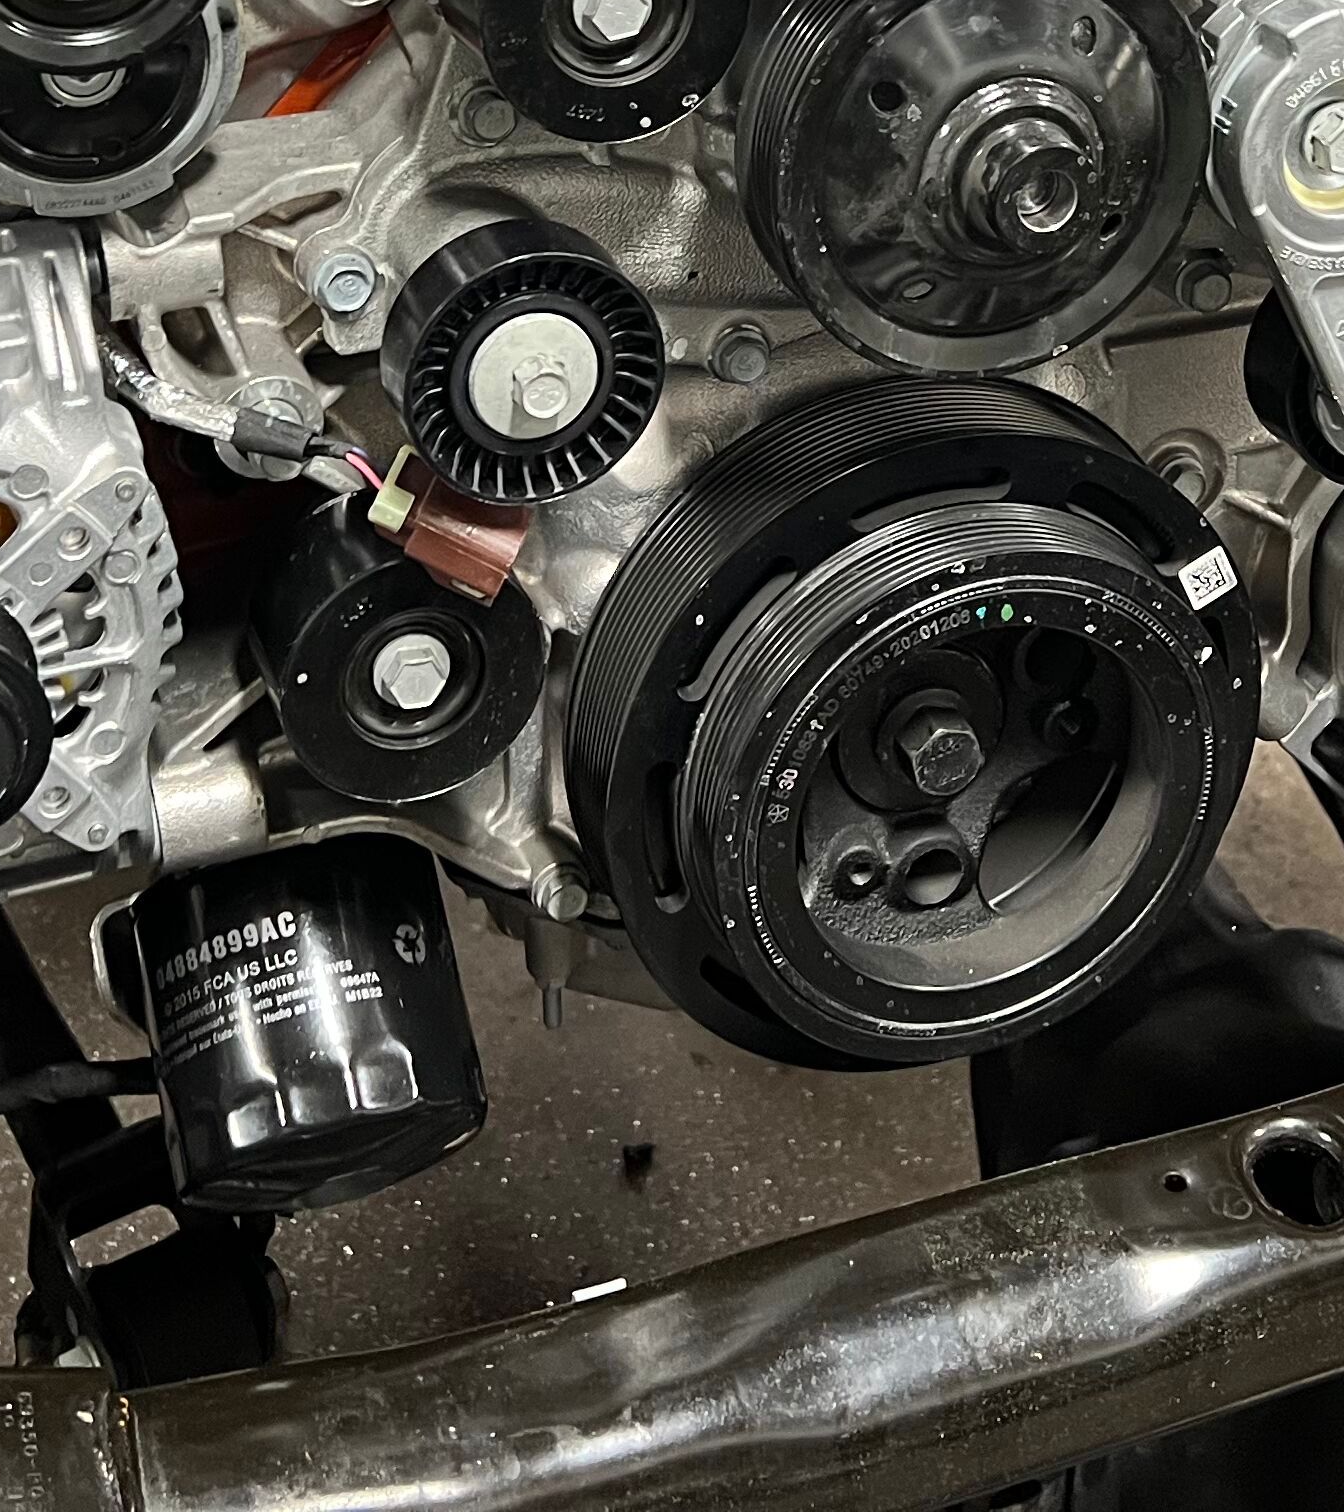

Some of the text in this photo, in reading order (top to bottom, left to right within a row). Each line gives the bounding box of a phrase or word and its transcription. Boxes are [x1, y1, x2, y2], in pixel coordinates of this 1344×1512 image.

[156, 911, 297, 991] 04884899AC
[204, 970, 235, 996] FCA
[237, 960, 261, 984] US
[264, 948, 298, 972] LLC
[253, 972, 295, 996] DROITS
